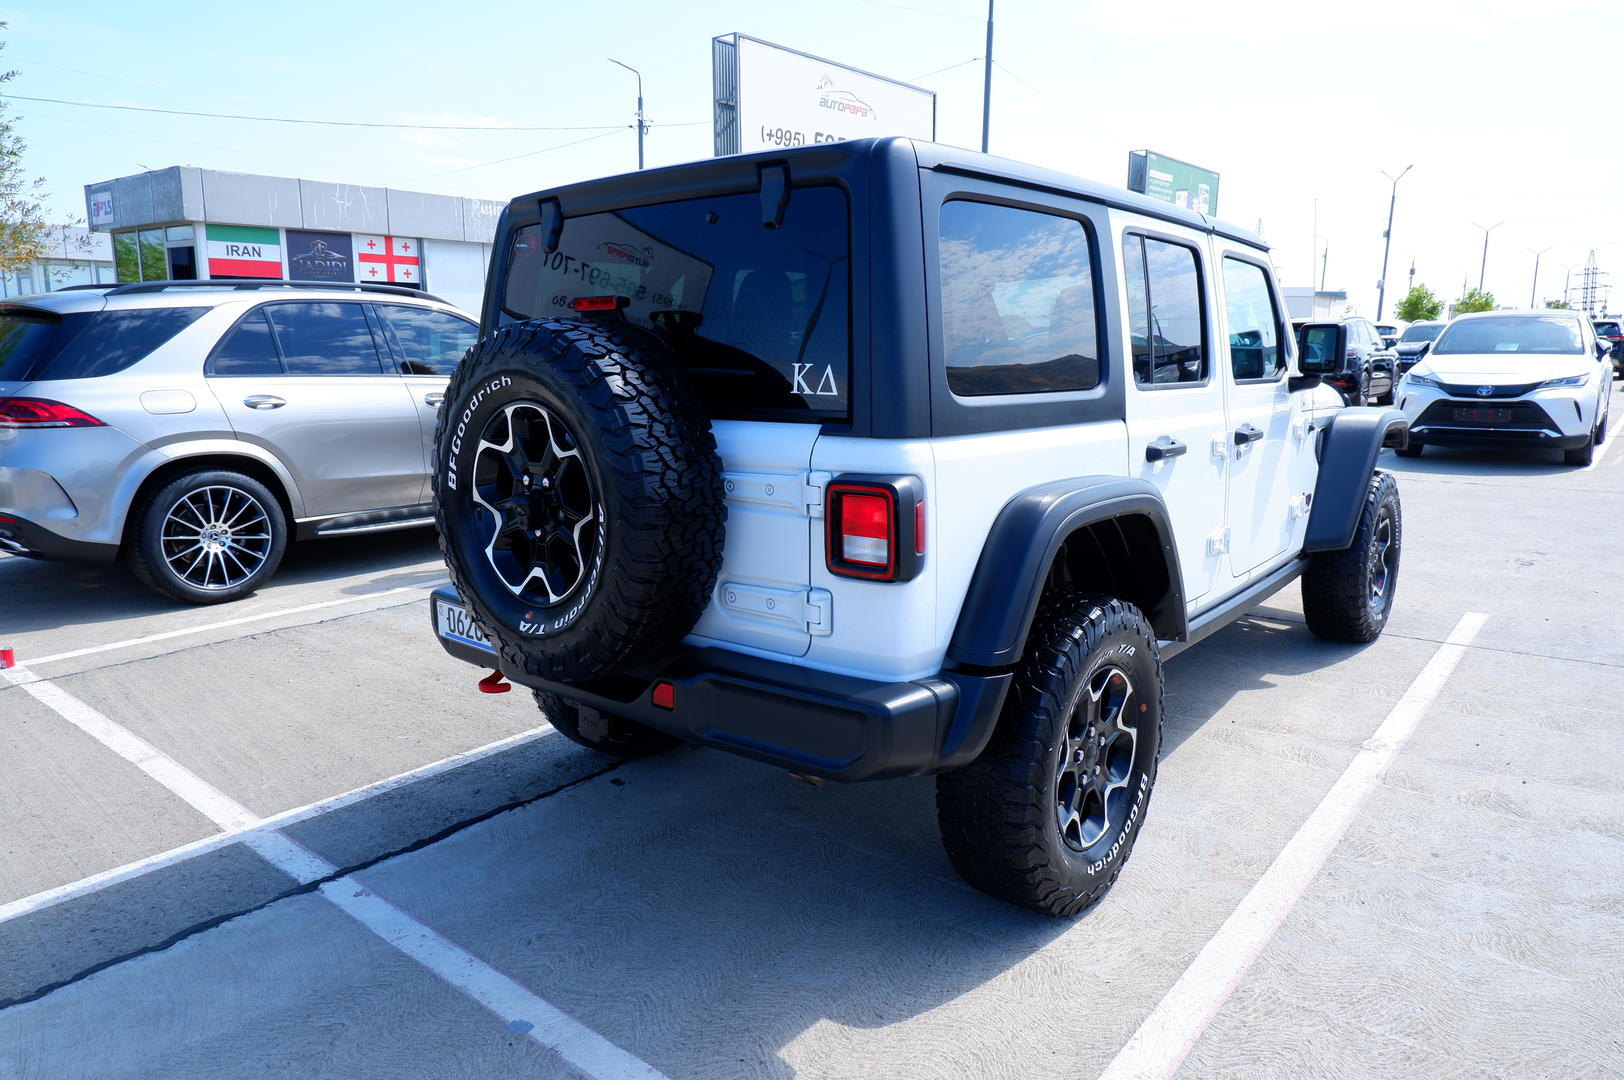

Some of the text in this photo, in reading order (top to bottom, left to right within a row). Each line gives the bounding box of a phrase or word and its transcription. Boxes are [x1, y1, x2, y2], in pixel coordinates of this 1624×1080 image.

[225, 244, 262, 258] IRAN
[447, 375, 512, 491] BFGoodrich
[519, 620, 546, 635] T/A
[1118, 643, 1136, 657] T/A
[1087, 772, 1148, 876] BFGoodrich
